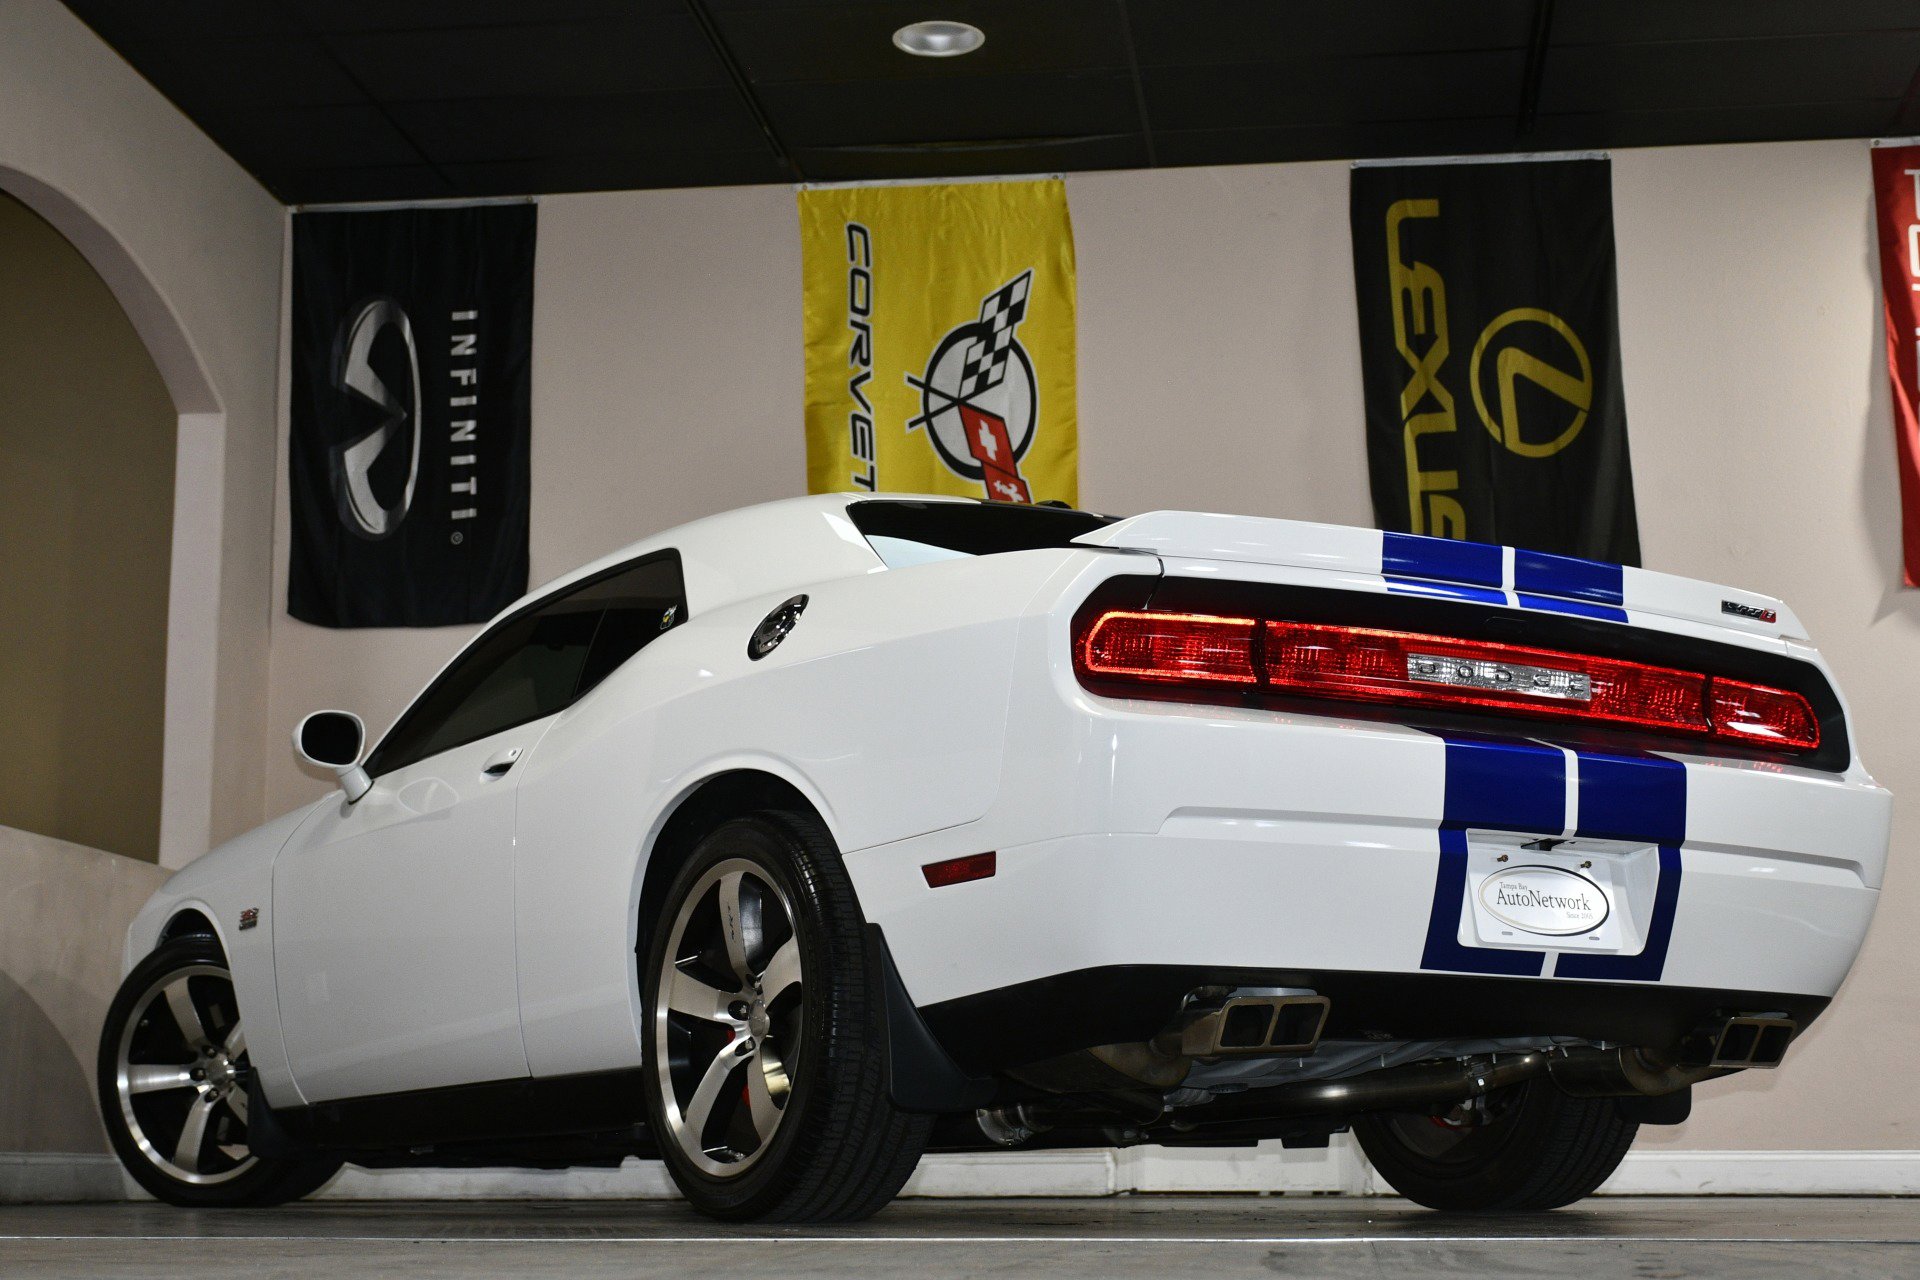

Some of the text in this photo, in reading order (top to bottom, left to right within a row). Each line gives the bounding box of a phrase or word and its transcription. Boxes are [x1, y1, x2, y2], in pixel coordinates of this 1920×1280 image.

[451, 310, 478, 520] INFINITI
[1500, 882, 1528, 891] Tampa Bay
[1497, 888, 1591, 910] AutoNetwork
[1566, 911, 1580, 919] Since
